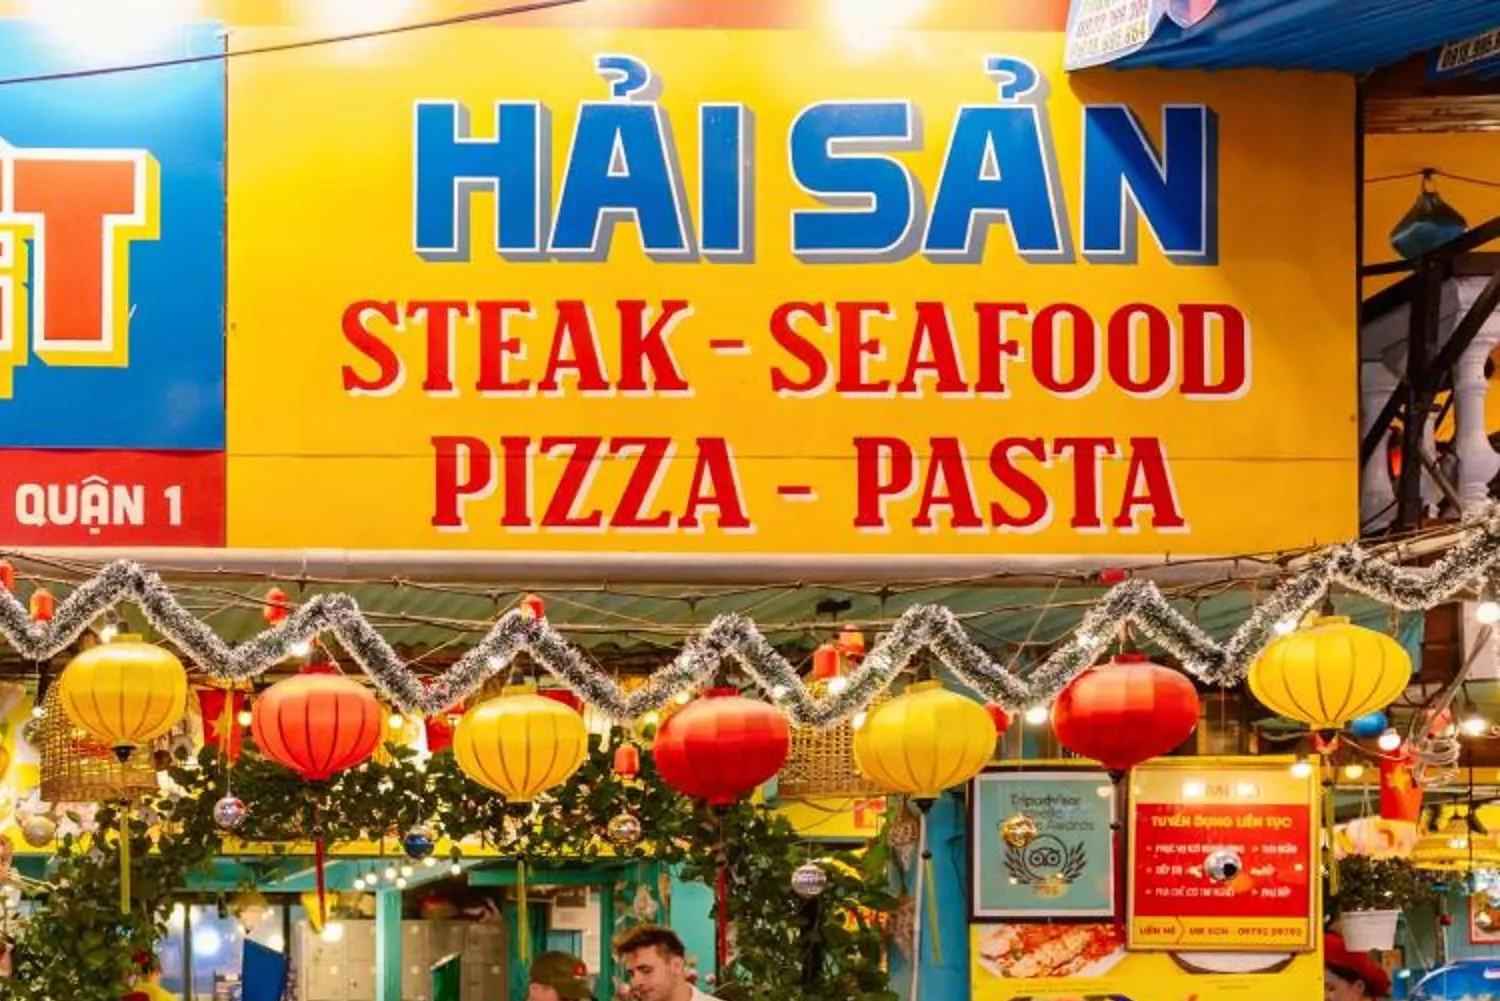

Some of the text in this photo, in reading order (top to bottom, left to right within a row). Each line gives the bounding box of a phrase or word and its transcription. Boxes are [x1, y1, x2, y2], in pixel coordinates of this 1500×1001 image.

[412, 54, 1214, 264] HẢI SẢN
[341, 300, 694, 397] STEAK
[769, 302, 1252, 400] SEAFOOD
[15, 475, 144, 535] QUẬN
[164, 485, 182, 526] 1
[431, 436, 757, 534] PIZZA
[853, 437, 1190, 534] PASTA
